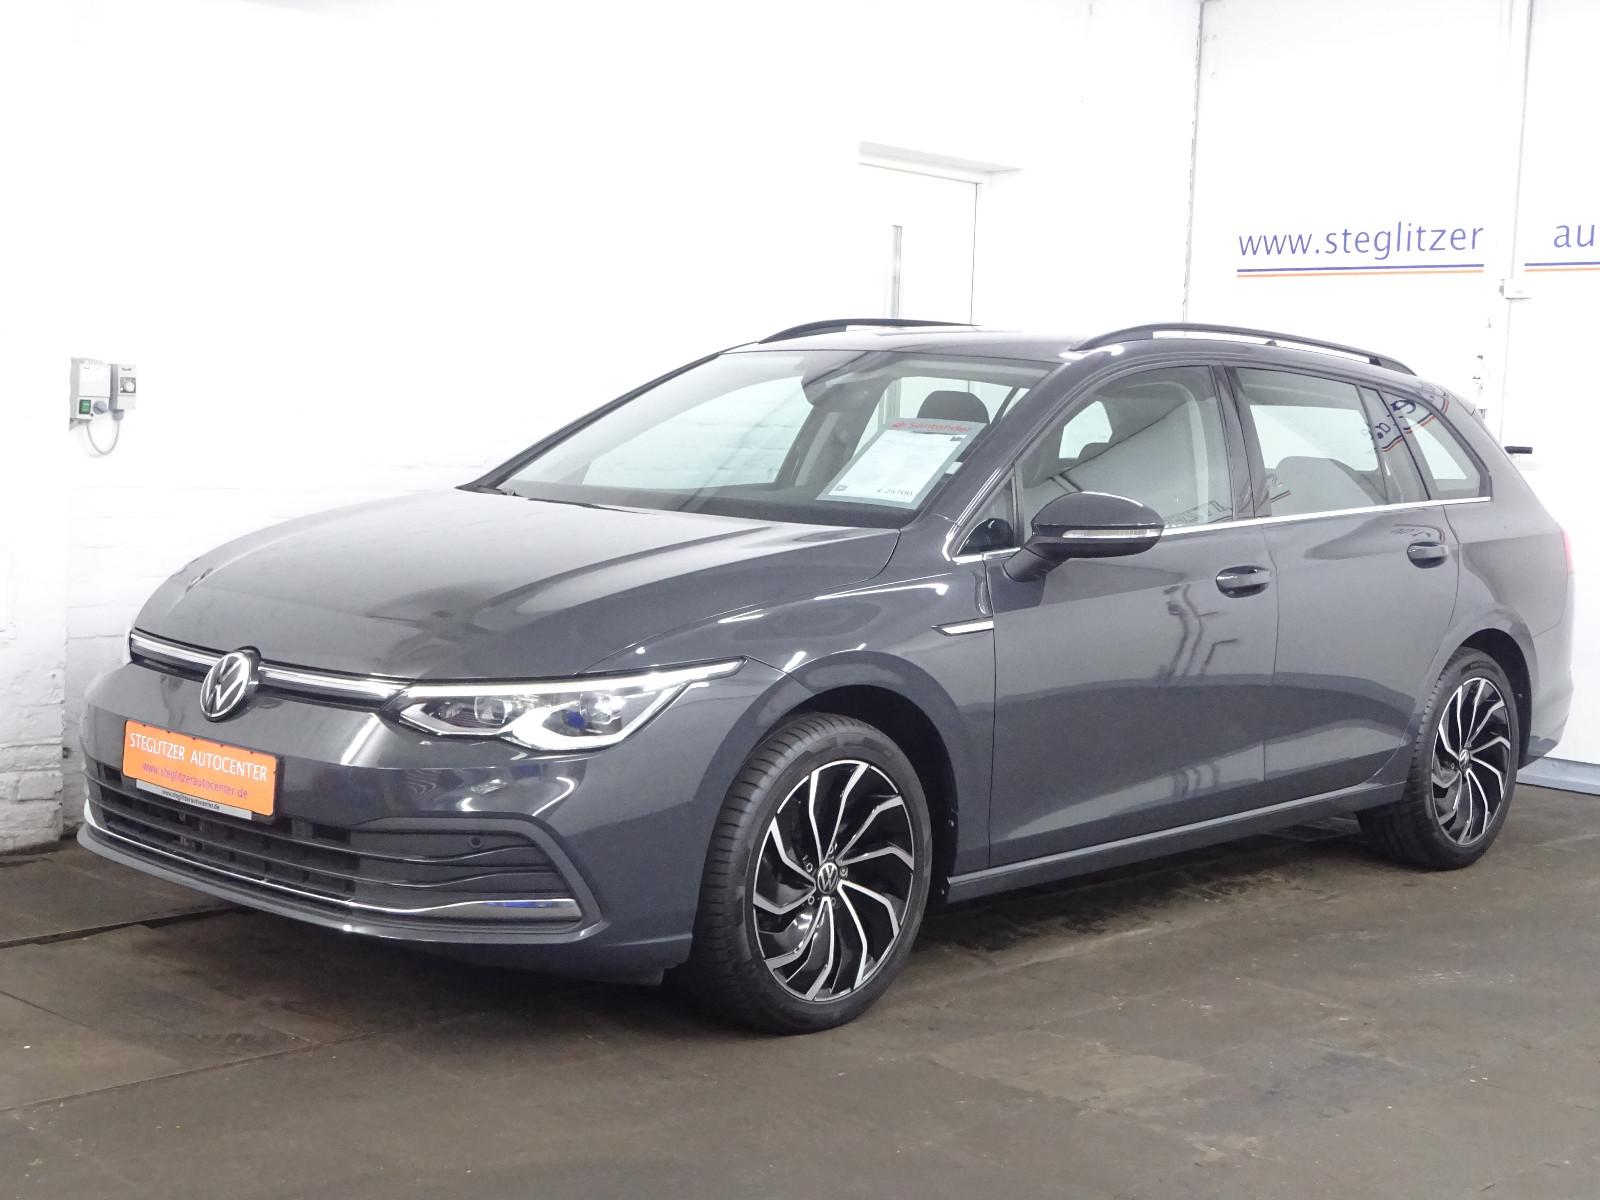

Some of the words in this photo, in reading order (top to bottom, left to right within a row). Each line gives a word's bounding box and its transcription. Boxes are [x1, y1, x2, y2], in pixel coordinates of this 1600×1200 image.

[1238, 221, 1484, 260] www.steglitzer
[1553, 223, 1596, 249] au
[129, 732, 185, 762] STEGLITZER
[190, 749, 267, 782] AUTOCENTER
[142, 761, 248, 799] www.steglitzerautocenter.de
